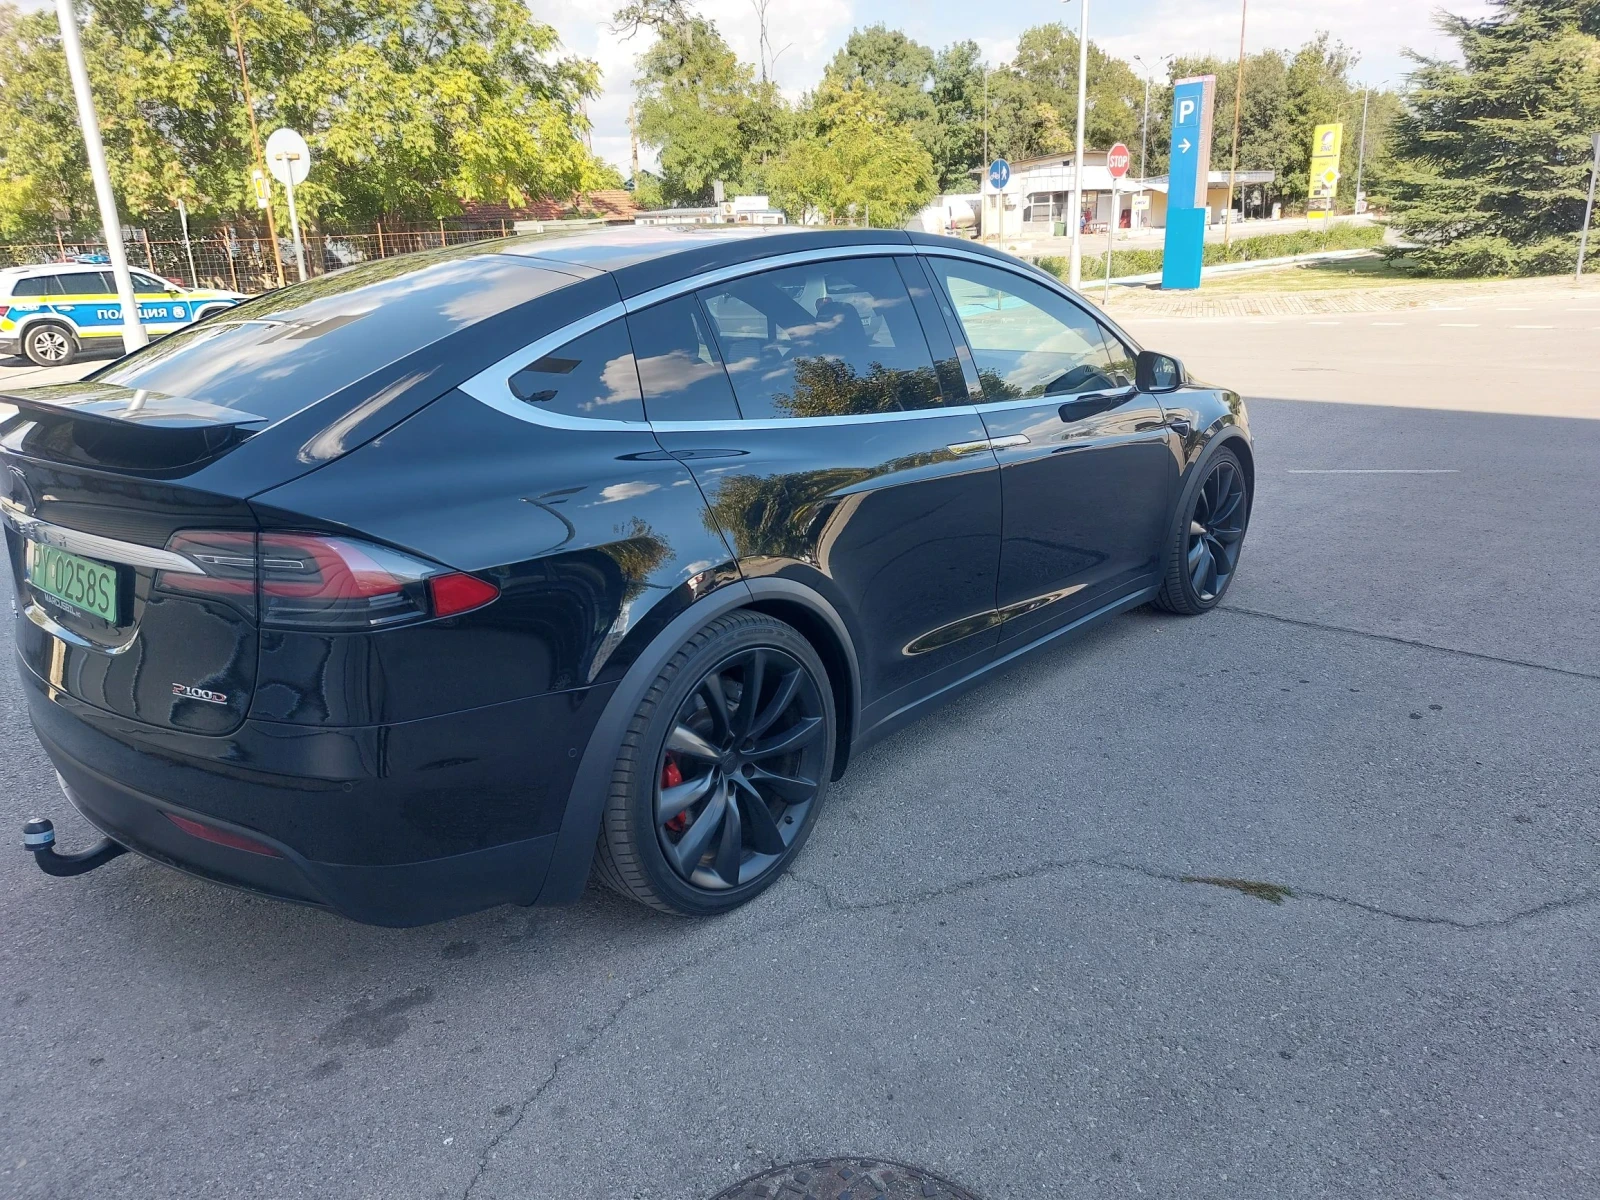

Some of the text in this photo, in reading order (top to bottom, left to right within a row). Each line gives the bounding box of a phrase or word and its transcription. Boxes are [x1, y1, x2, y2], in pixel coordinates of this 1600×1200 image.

[1179, 100, 1194, 124] P
[1110, 156, 1127, 168] STOP
[97, 308, 168, 319] ПОЦИЯ
[172, 683, 227, 704] P100D
